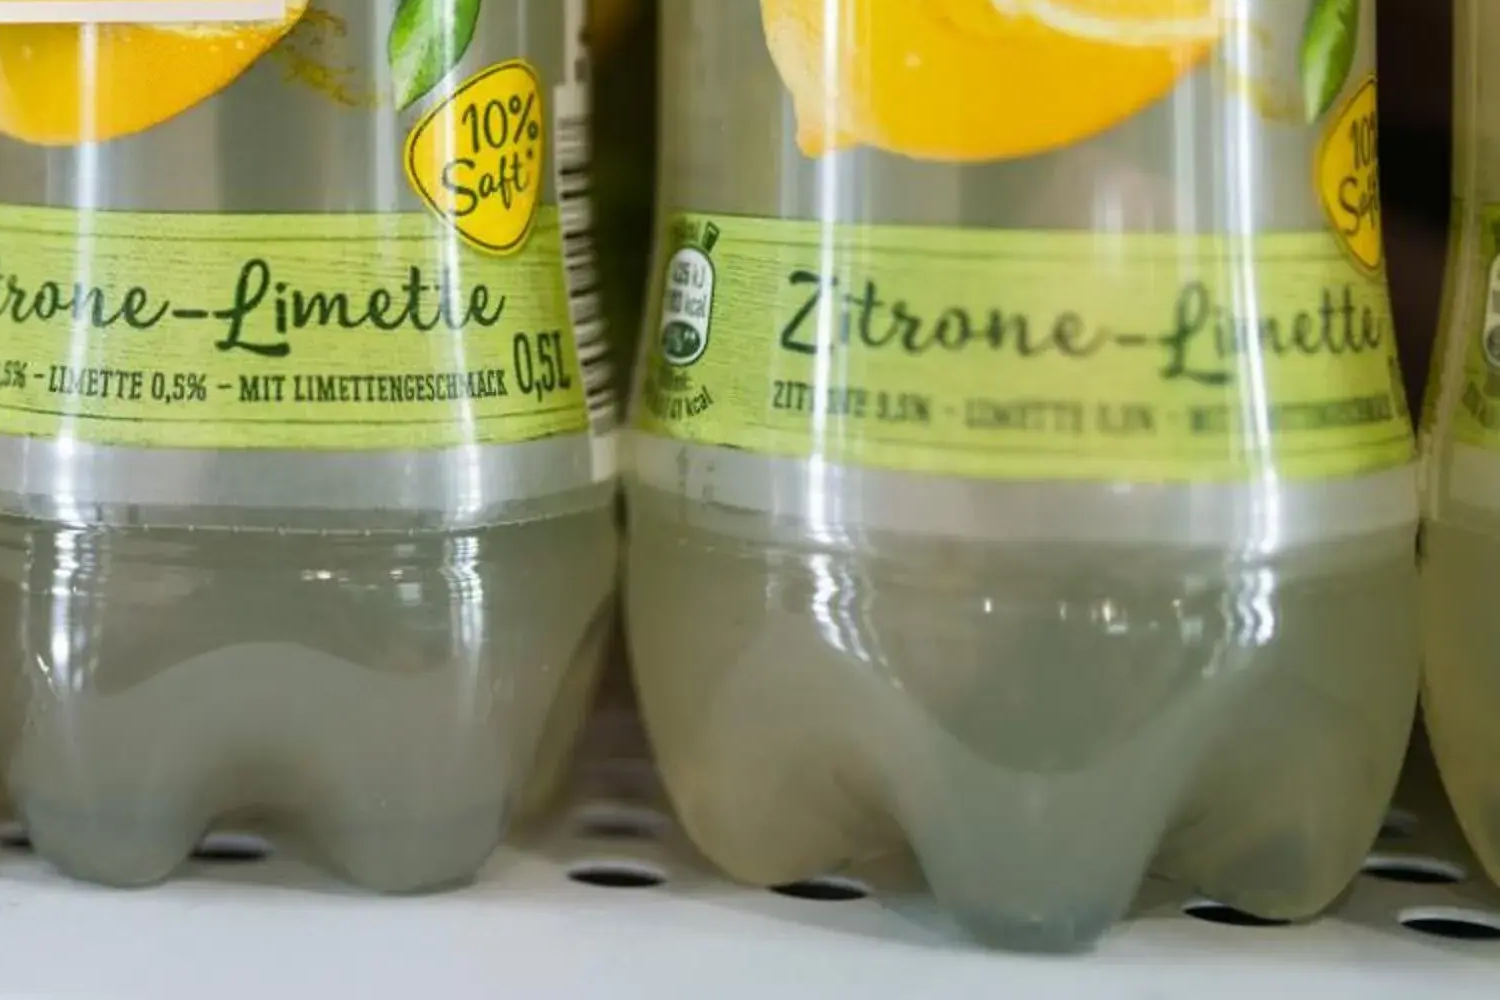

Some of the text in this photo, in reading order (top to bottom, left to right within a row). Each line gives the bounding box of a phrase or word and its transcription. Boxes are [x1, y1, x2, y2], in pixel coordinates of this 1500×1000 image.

[462, 92, 540, 153] 10%
[49, 365, 143, 400] LIMETTE
[151, 372, 207, 405] 0,5%
[239, 374, 286, 401] MIT
[293, 368, 509, 403] LIMETTENGESCHMACK
[513, 329, 571, 403] 0,5L
